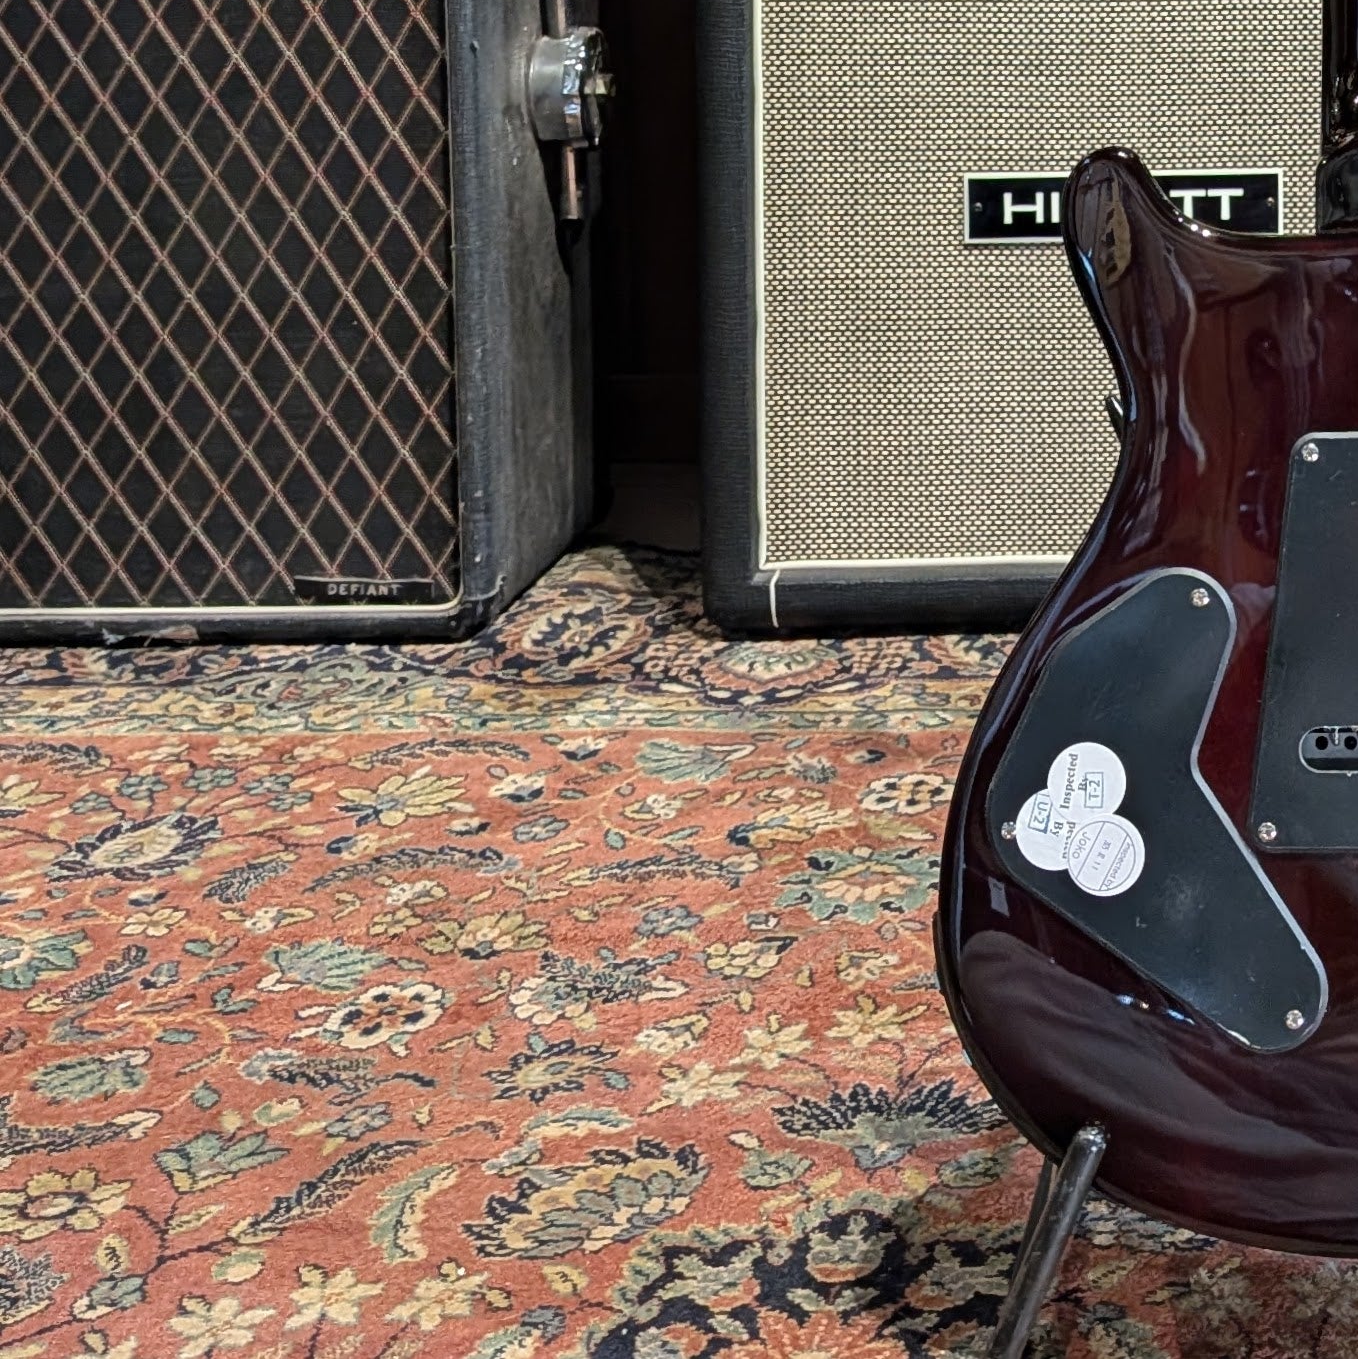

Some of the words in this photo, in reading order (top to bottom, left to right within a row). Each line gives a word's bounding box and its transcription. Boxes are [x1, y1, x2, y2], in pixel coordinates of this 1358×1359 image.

[1003, 188, 1244, 225] HITT
[327, 583, 401, 596] DEFIANT
[1059, 753, 1079, 810] Inspected
[1088, 780, 1101, 801] T-2
[1033, 801, 1049, 825] U-2
[1050, 821, 1064, 838] By
[1072, 831, 1092, 859] Joko
